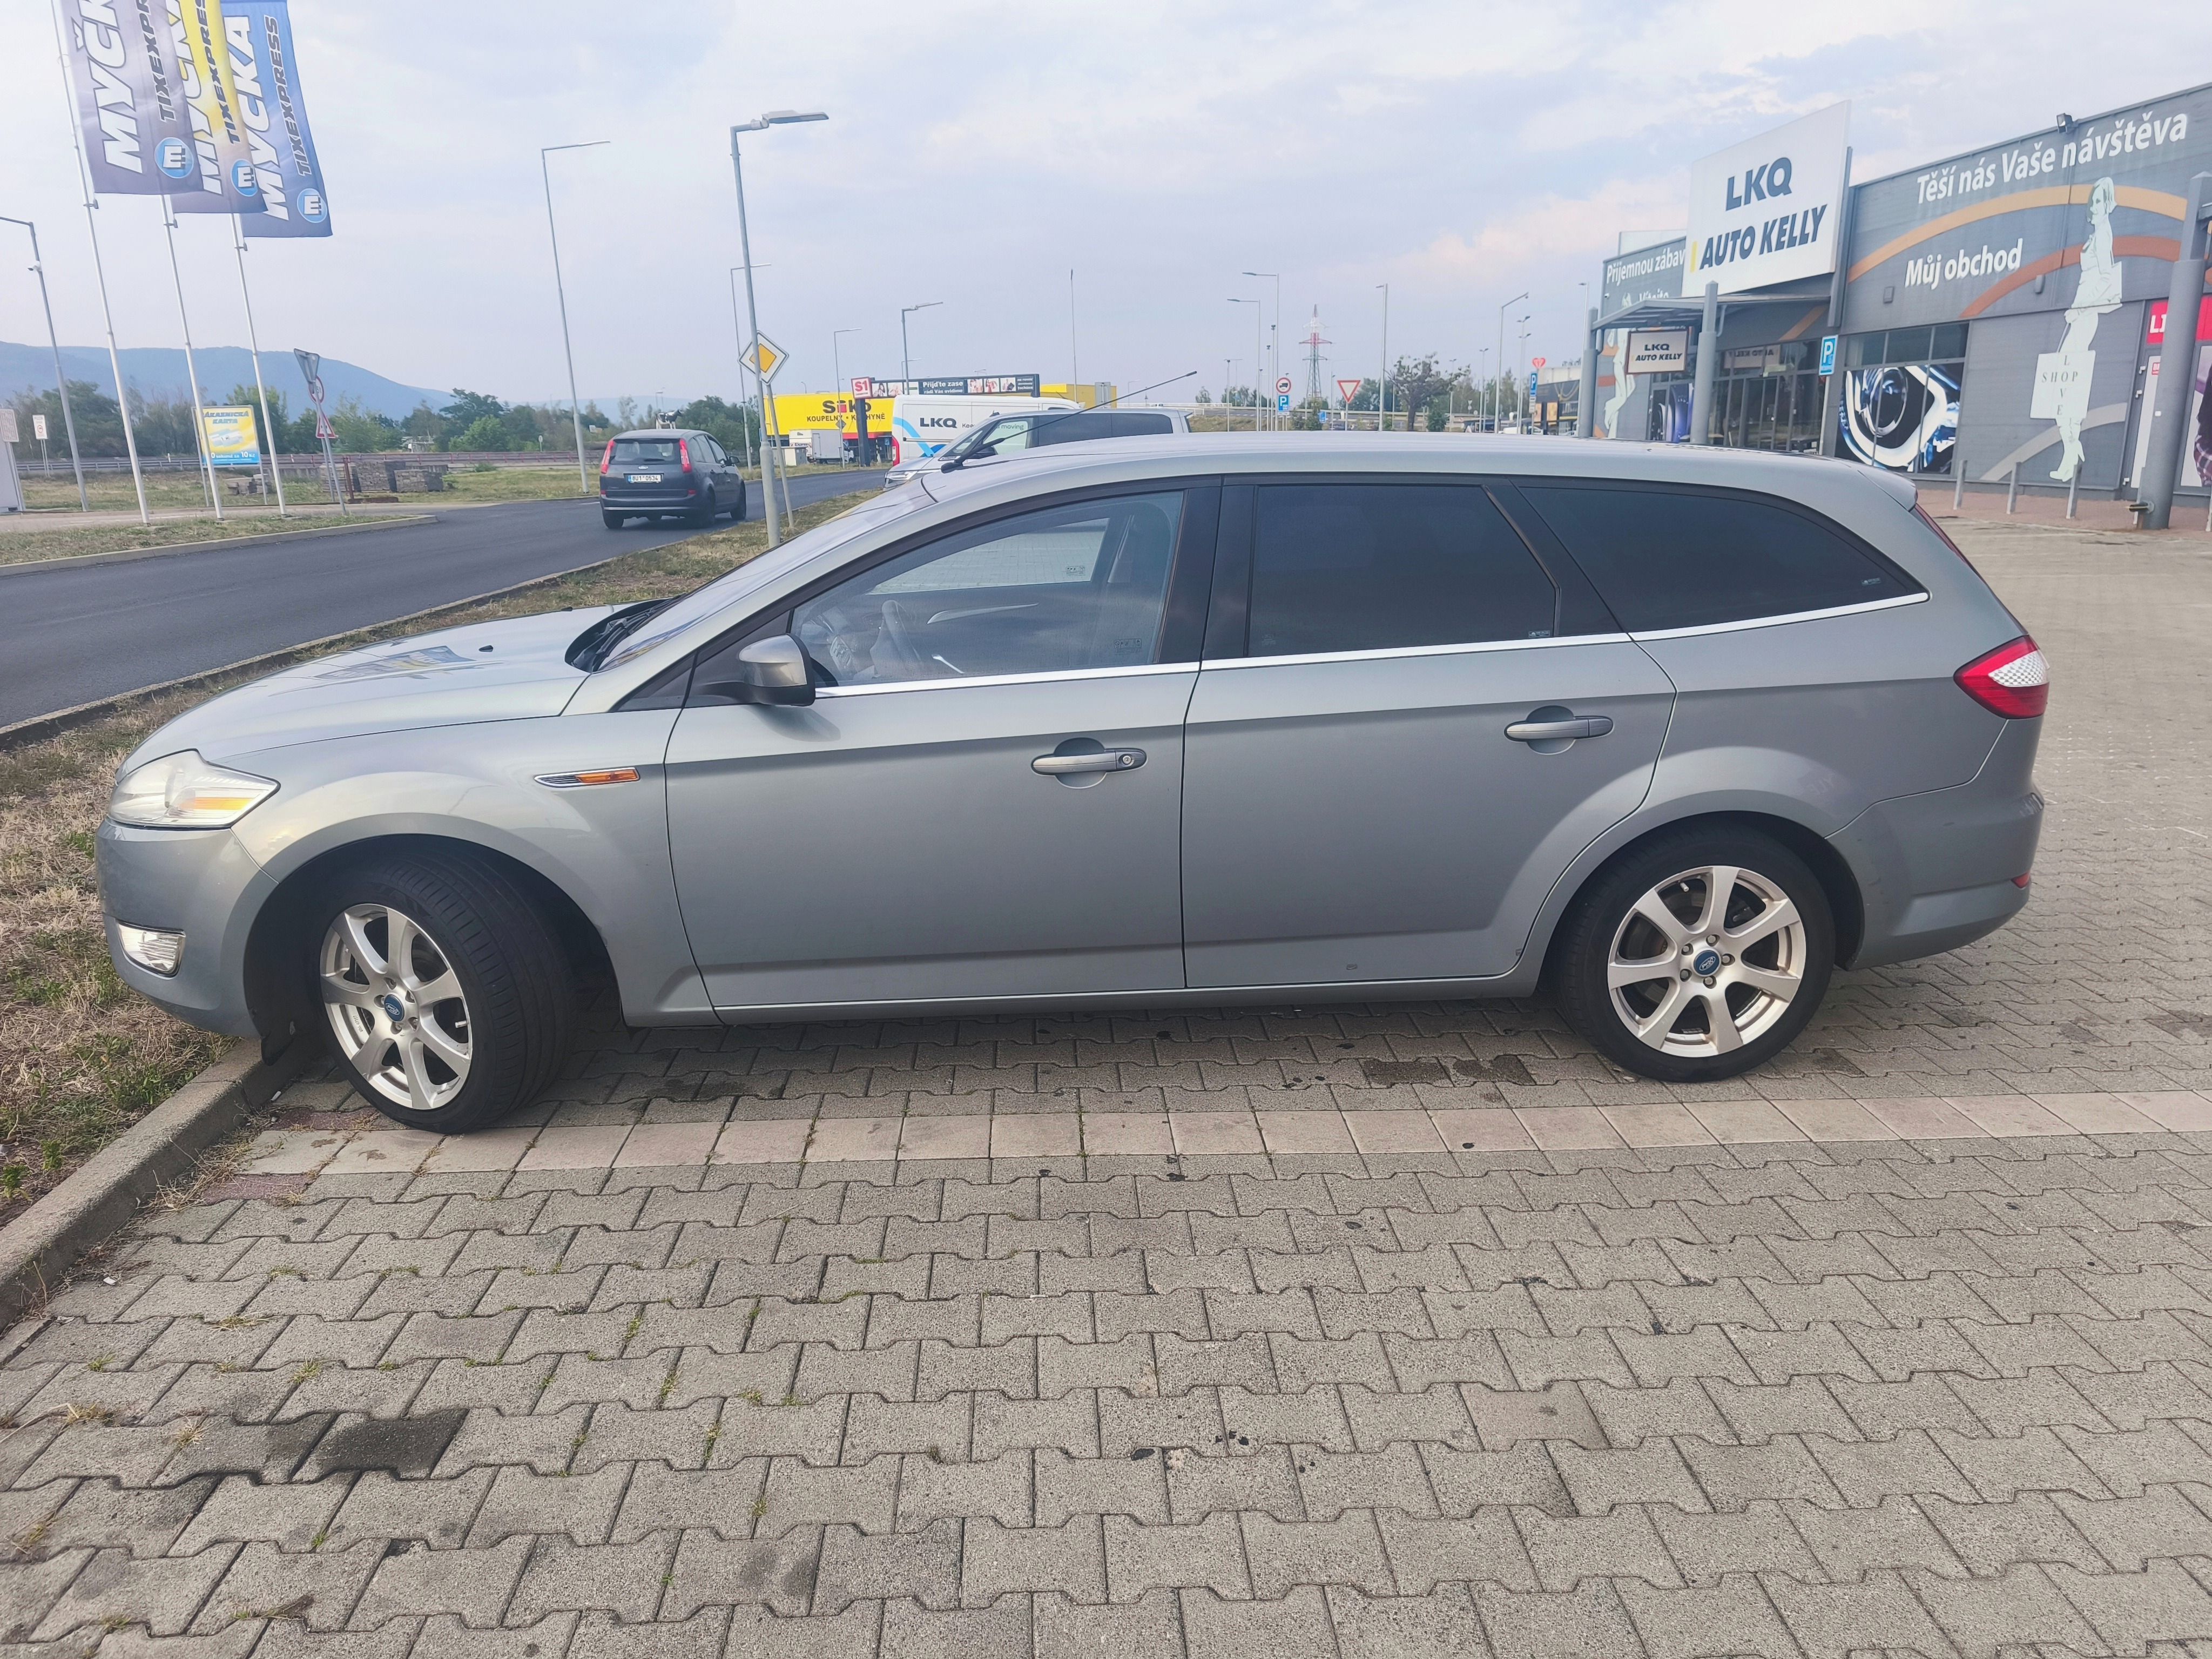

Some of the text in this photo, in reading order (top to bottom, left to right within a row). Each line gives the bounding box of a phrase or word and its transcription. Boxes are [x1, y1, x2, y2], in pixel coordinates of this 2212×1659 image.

[264, 15, 312, 177] TIXEXPRESS
[1917, 111, 2188, 204] Těší nás Vaše návštěva
[1725, 157, 1792, 211] LKQ
[1700, 204, 1827, 270] AUTO KELLY
[1607, 258, 1654, 286] Příjemnou
[1905, 238, 2023, 290] Můj obchod
[1823, 341, 1833, 363] P
[855, 380, 868, 392] S1
[2042, 371, 2078, 383] SHOP
[1280, 396, 1287, 407] P
[851, 413, 885, 421] KHYNĚ
[920, 417, 957, 428] LKQ
